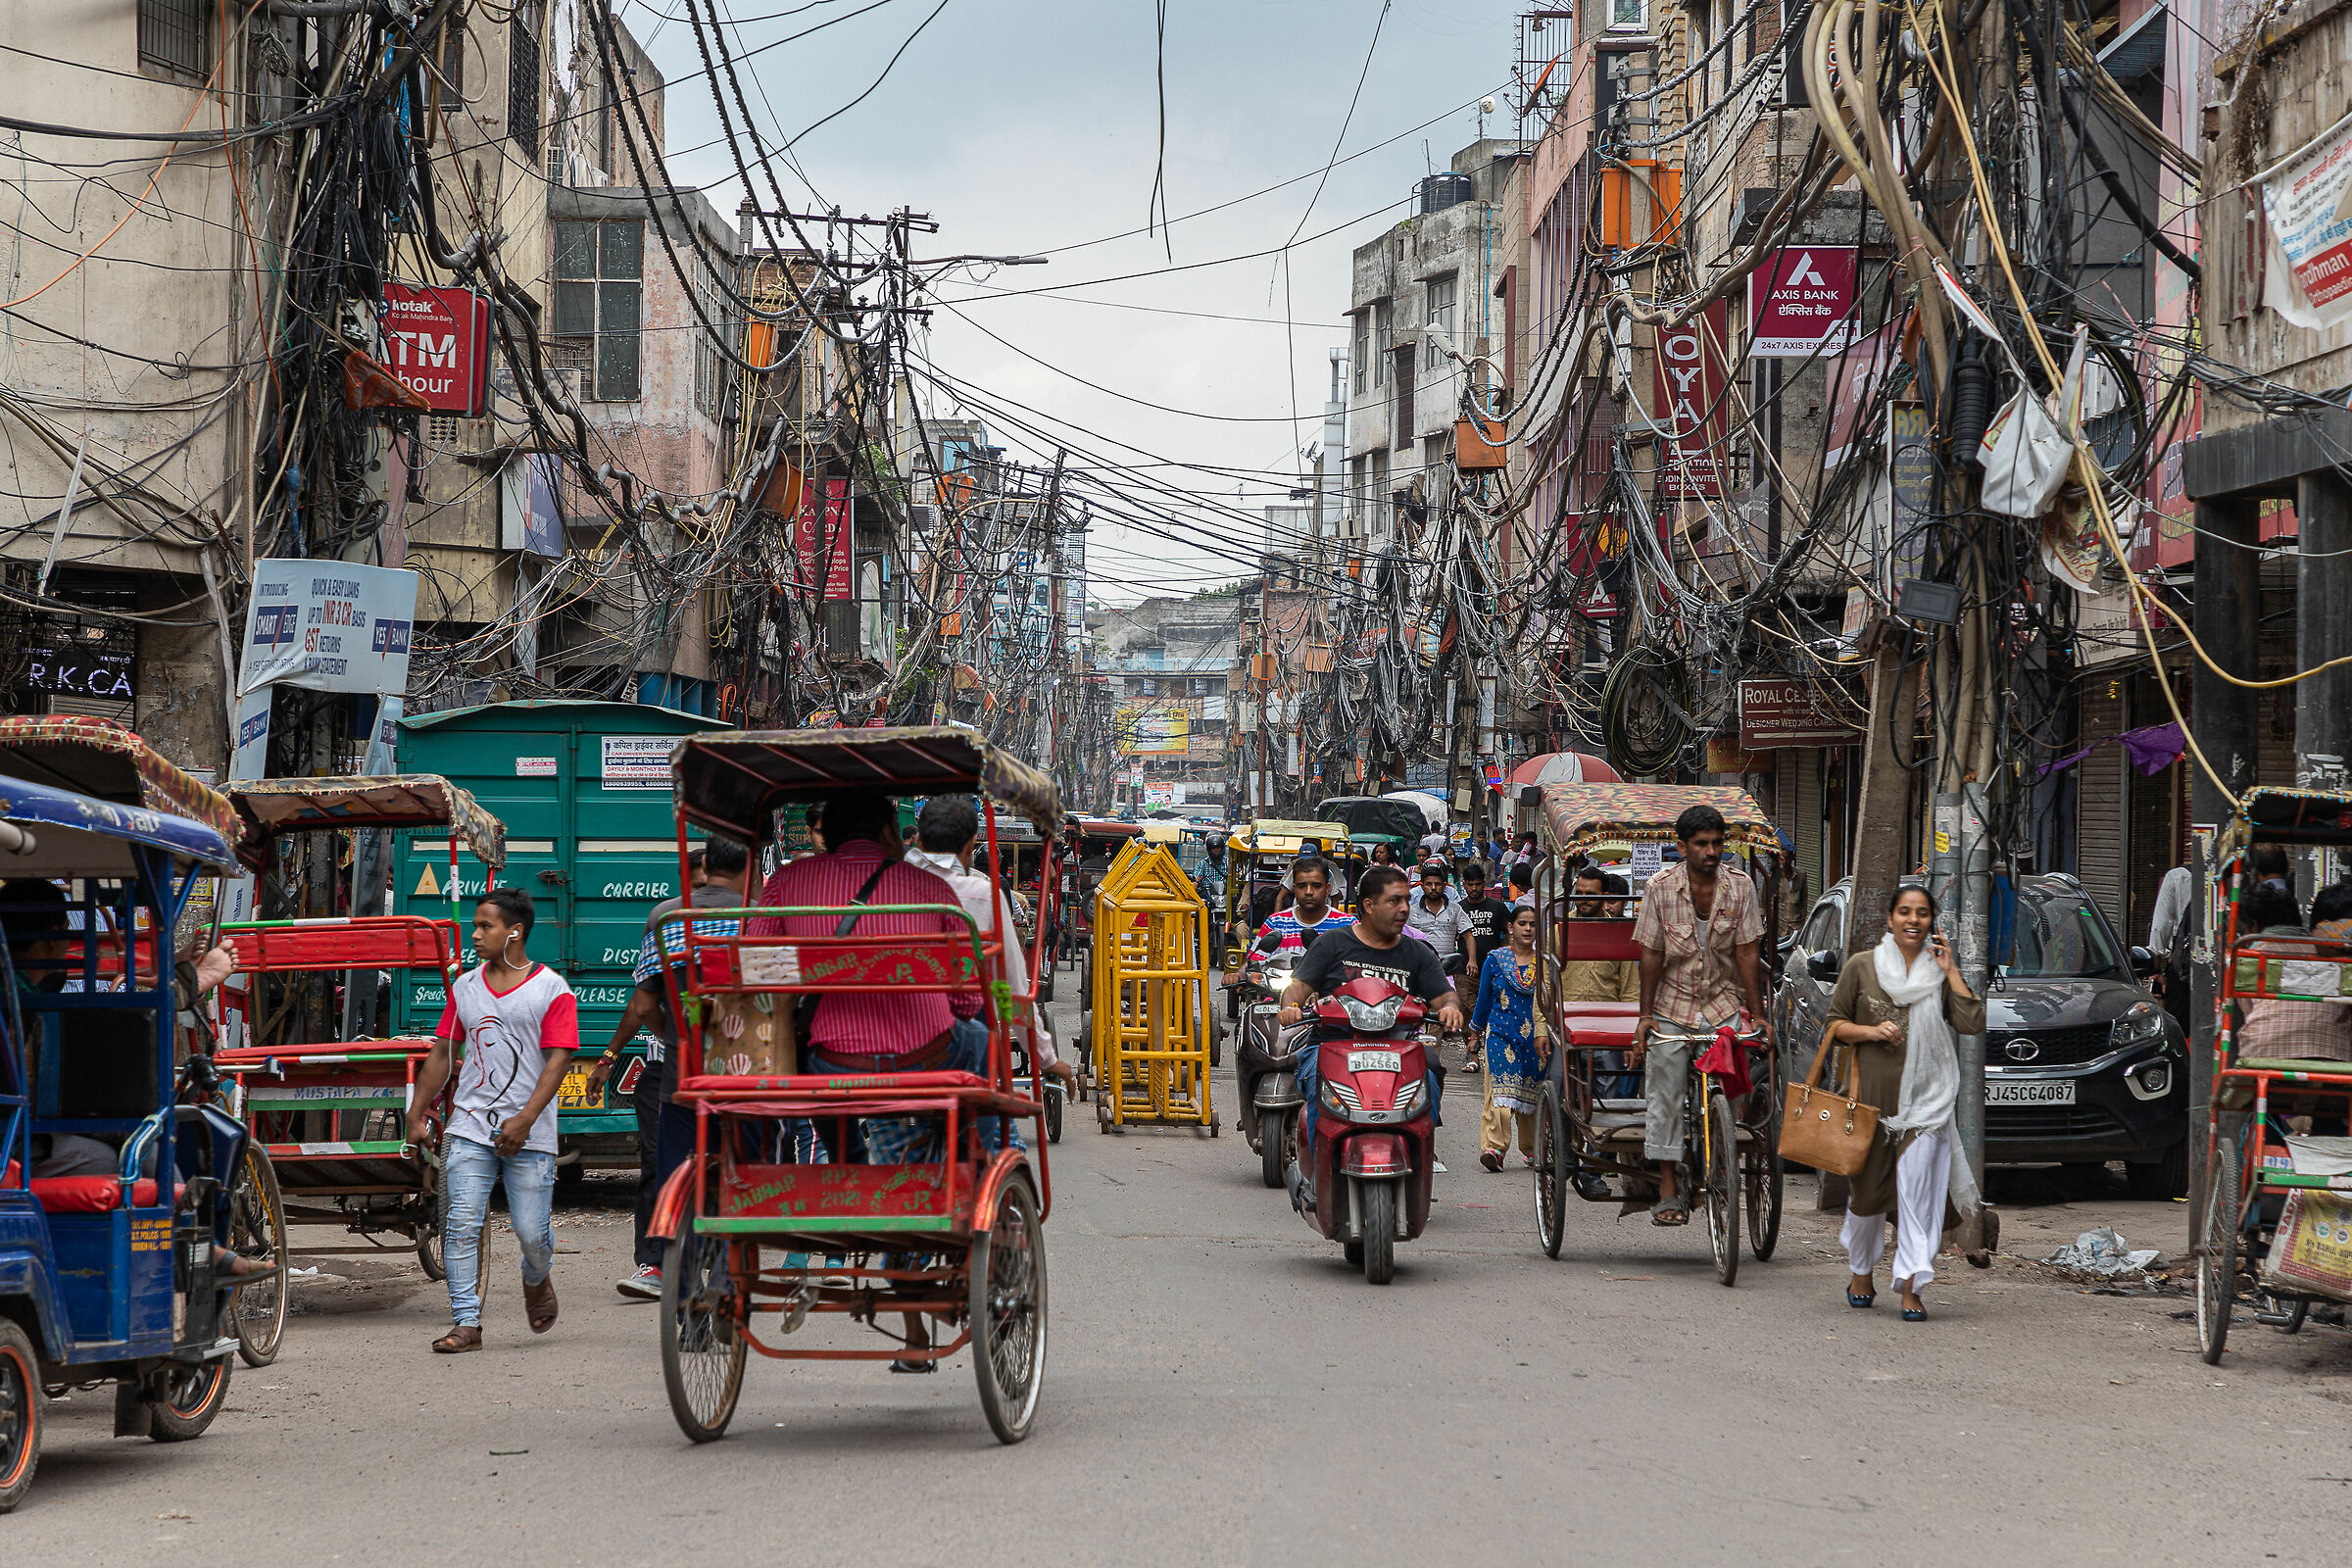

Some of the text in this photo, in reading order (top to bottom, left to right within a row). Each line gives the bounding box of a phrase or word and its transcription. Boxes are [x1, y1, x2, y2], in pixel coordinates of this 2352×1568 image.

[1771, 289, 1839, 300] AXIS BANK
[392, 299, 432, 314] kotak
[411, 313, 438, 321] Mahindra
[1761, 341, 1781, 350] 24x7
[1783, 341, 1804, 350] AXIS
[398, 369, 454, 394] hour
[259, 583, 289, 596] INTRODUCING
[312, 578, 327, 598] QUICK
[331, 579, 344, 597] EASY
[344, 581, 361, 599] LOANS
[308, 599, 367, 628] UP TO INR 3 CR BASIS
[256, 613, 297, 636] SMART EDGE
[305, 627, 341, 654] GST RETURNS
[375, 625, 409, 646] YES BANK
[319, 660, 349, 676] STATEMENT
[1744, 687, 1783, 705] ROYAL
[241, 714, 267, 742] YES BANK
[603, 882, 669, 899] CARRIER
[1469, 909, 1494, 918] More
[1361, 962, 1386, 972] EFFECTS
[1386, 965, 1411, 977] DESIGNER
[574, 987, 627, 1004] PLEASE
[1984, 1086, 2074, 1102] RJ45CG4087
